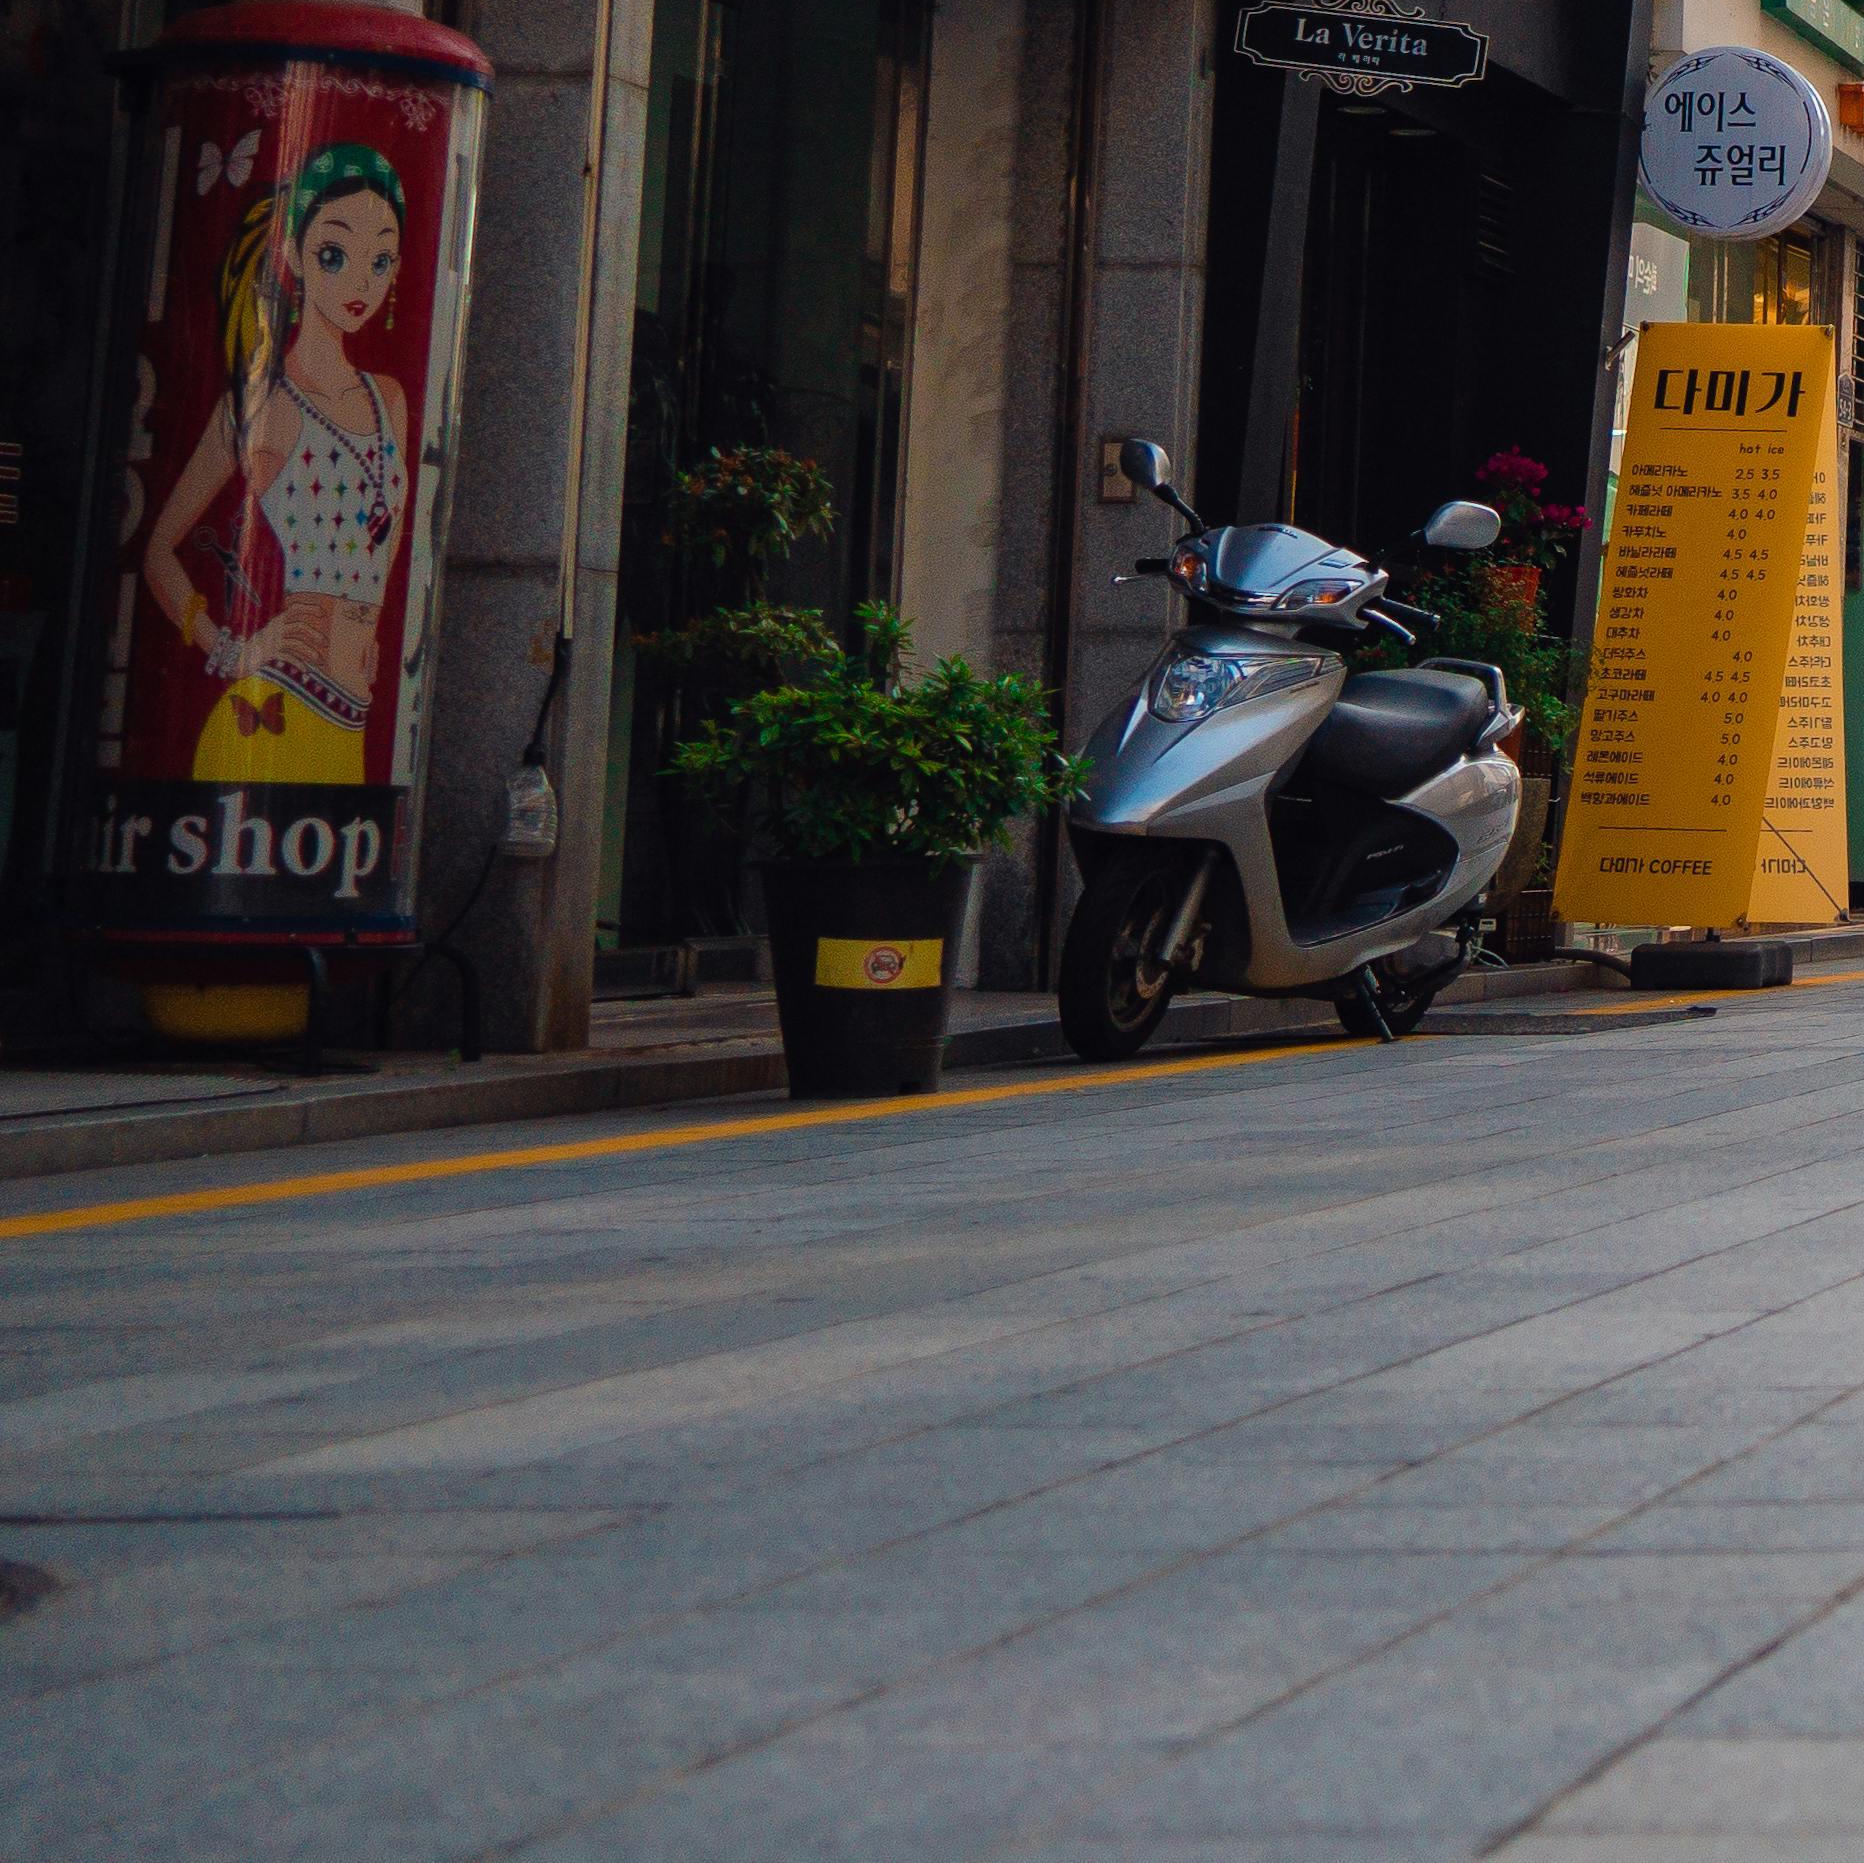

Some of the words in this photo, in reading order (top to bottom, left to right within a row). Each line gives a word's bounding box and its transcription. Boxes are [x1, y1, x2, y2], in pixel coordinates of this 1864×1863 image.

[1295, 18, 1330, 45] La
[1342, 22, 1428, 56] Verita
[1665, 89, 1758, 132] 에이스
[1693, 144, 1787, 187] 쥬얼리
[1653, 369, 1806, 418] 다미가
[1738, 443, 1760, 455] hot
[1767, 443, 1785, 455] ice
[1735, 468, 1754, 480] 2.5
[1760, 469, 1780, 480] 3.5
[1731, 488, 1750, 500] 3.5
[1757, 488, 1777, 500] 4.0
[1728, 509, 1748, 520] 4.0
[1755, 509, 1775, 520] 4.0
[1726, 528, 1747, 540] 4.0
[1722, 549, 1742, 560] 4.5
[1749, 549, 1769, 560] 4.5
[1719, 569, 1739, 580] 4.5
[1746, 569, 1766, 580] 4.5
[1717, 590, 1737, 601] 4.0
[1714, 610, 1734, 621] 4.0
[1711, 630, 1731, 641] 4.0
[1732, 651, 1753, 662] 4.0
[1704, 671, 1724, 683] 4.5
[1730, 671, 1750, 683] 4.5
[1700, 692, 1720, 703] 4.0
[1728, 692, 1748, 703] 4.0
[1723, 713, 1744, 724] 5.0
[1720, 733, 1741, 745] 5.0
[1717, 754, 1738, 765] 4.0
[1714, 774, 1734, 785] 4.0
[1711, 795, 1731, 806] 4.0
[168, 791, 381, 898] shop
[1600, 857, 1644, 874] 다미가
[1650, 859, 1713, 875] COFFEE
